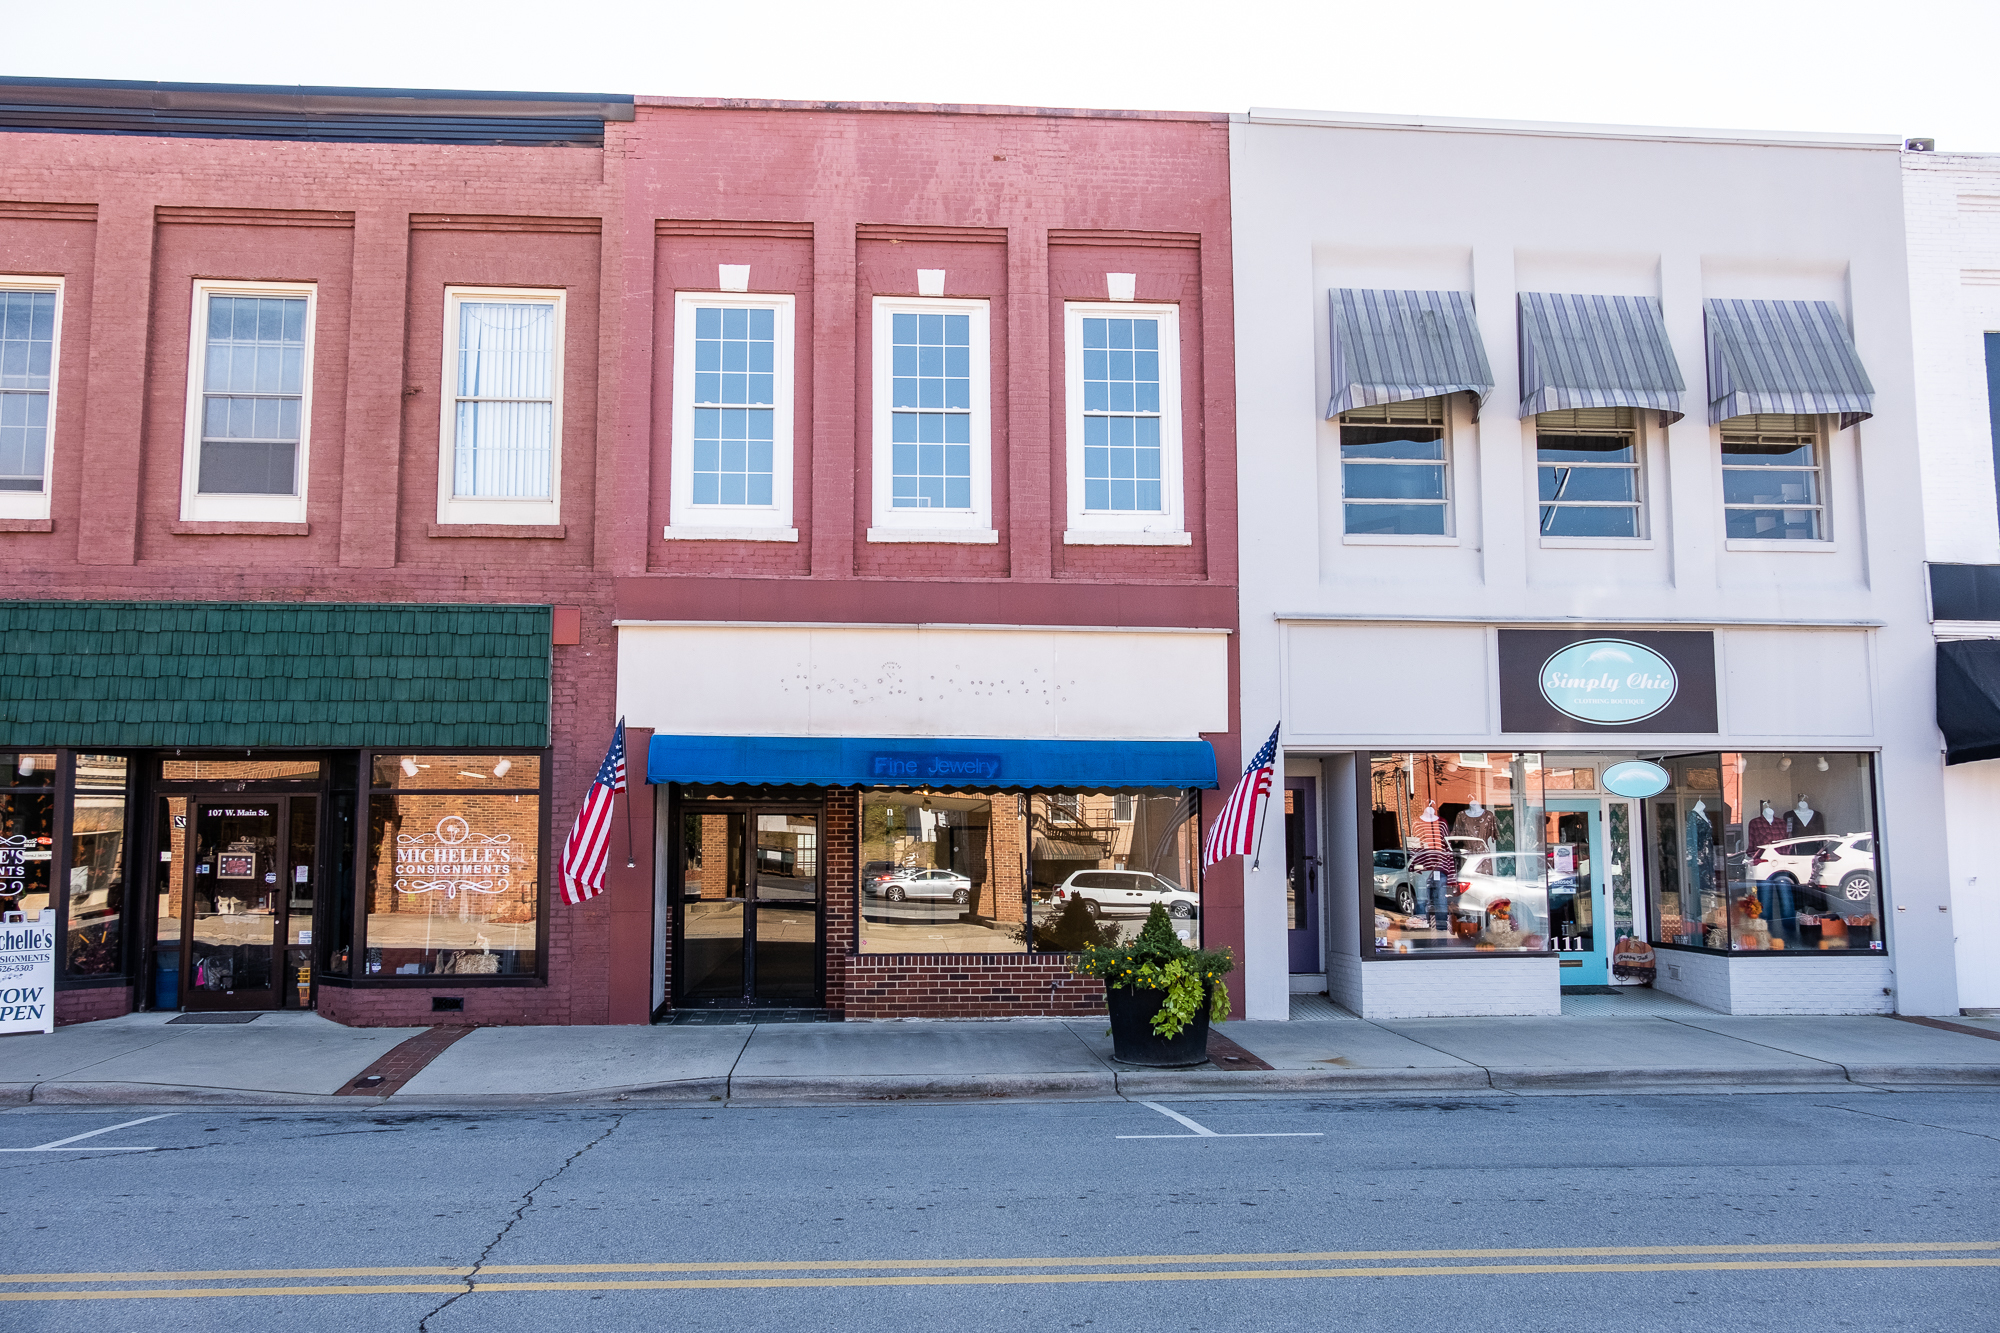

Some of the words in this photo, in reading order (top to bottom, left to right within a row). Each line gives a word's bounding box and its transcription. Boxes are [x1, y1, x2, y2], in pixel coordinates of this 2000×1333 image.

[1546, 671, 1622, 693] Simply
[1626, 672, 1671, 690] Chic
[875, 757, 918, 774] Fine
[928, 756, 999, 779] Jewelry
[208, 809, 223, 817] 107
[224, 809, 236, 817] W.
[236, 809, 257, 817] Main
[258, 809, 270, 817] St.
[396, 848, 511, 863] MICHELLE'S
[395, 864, 510, 874] CONSIGNMENTS
[1550, 936, 1584, 952] 111
